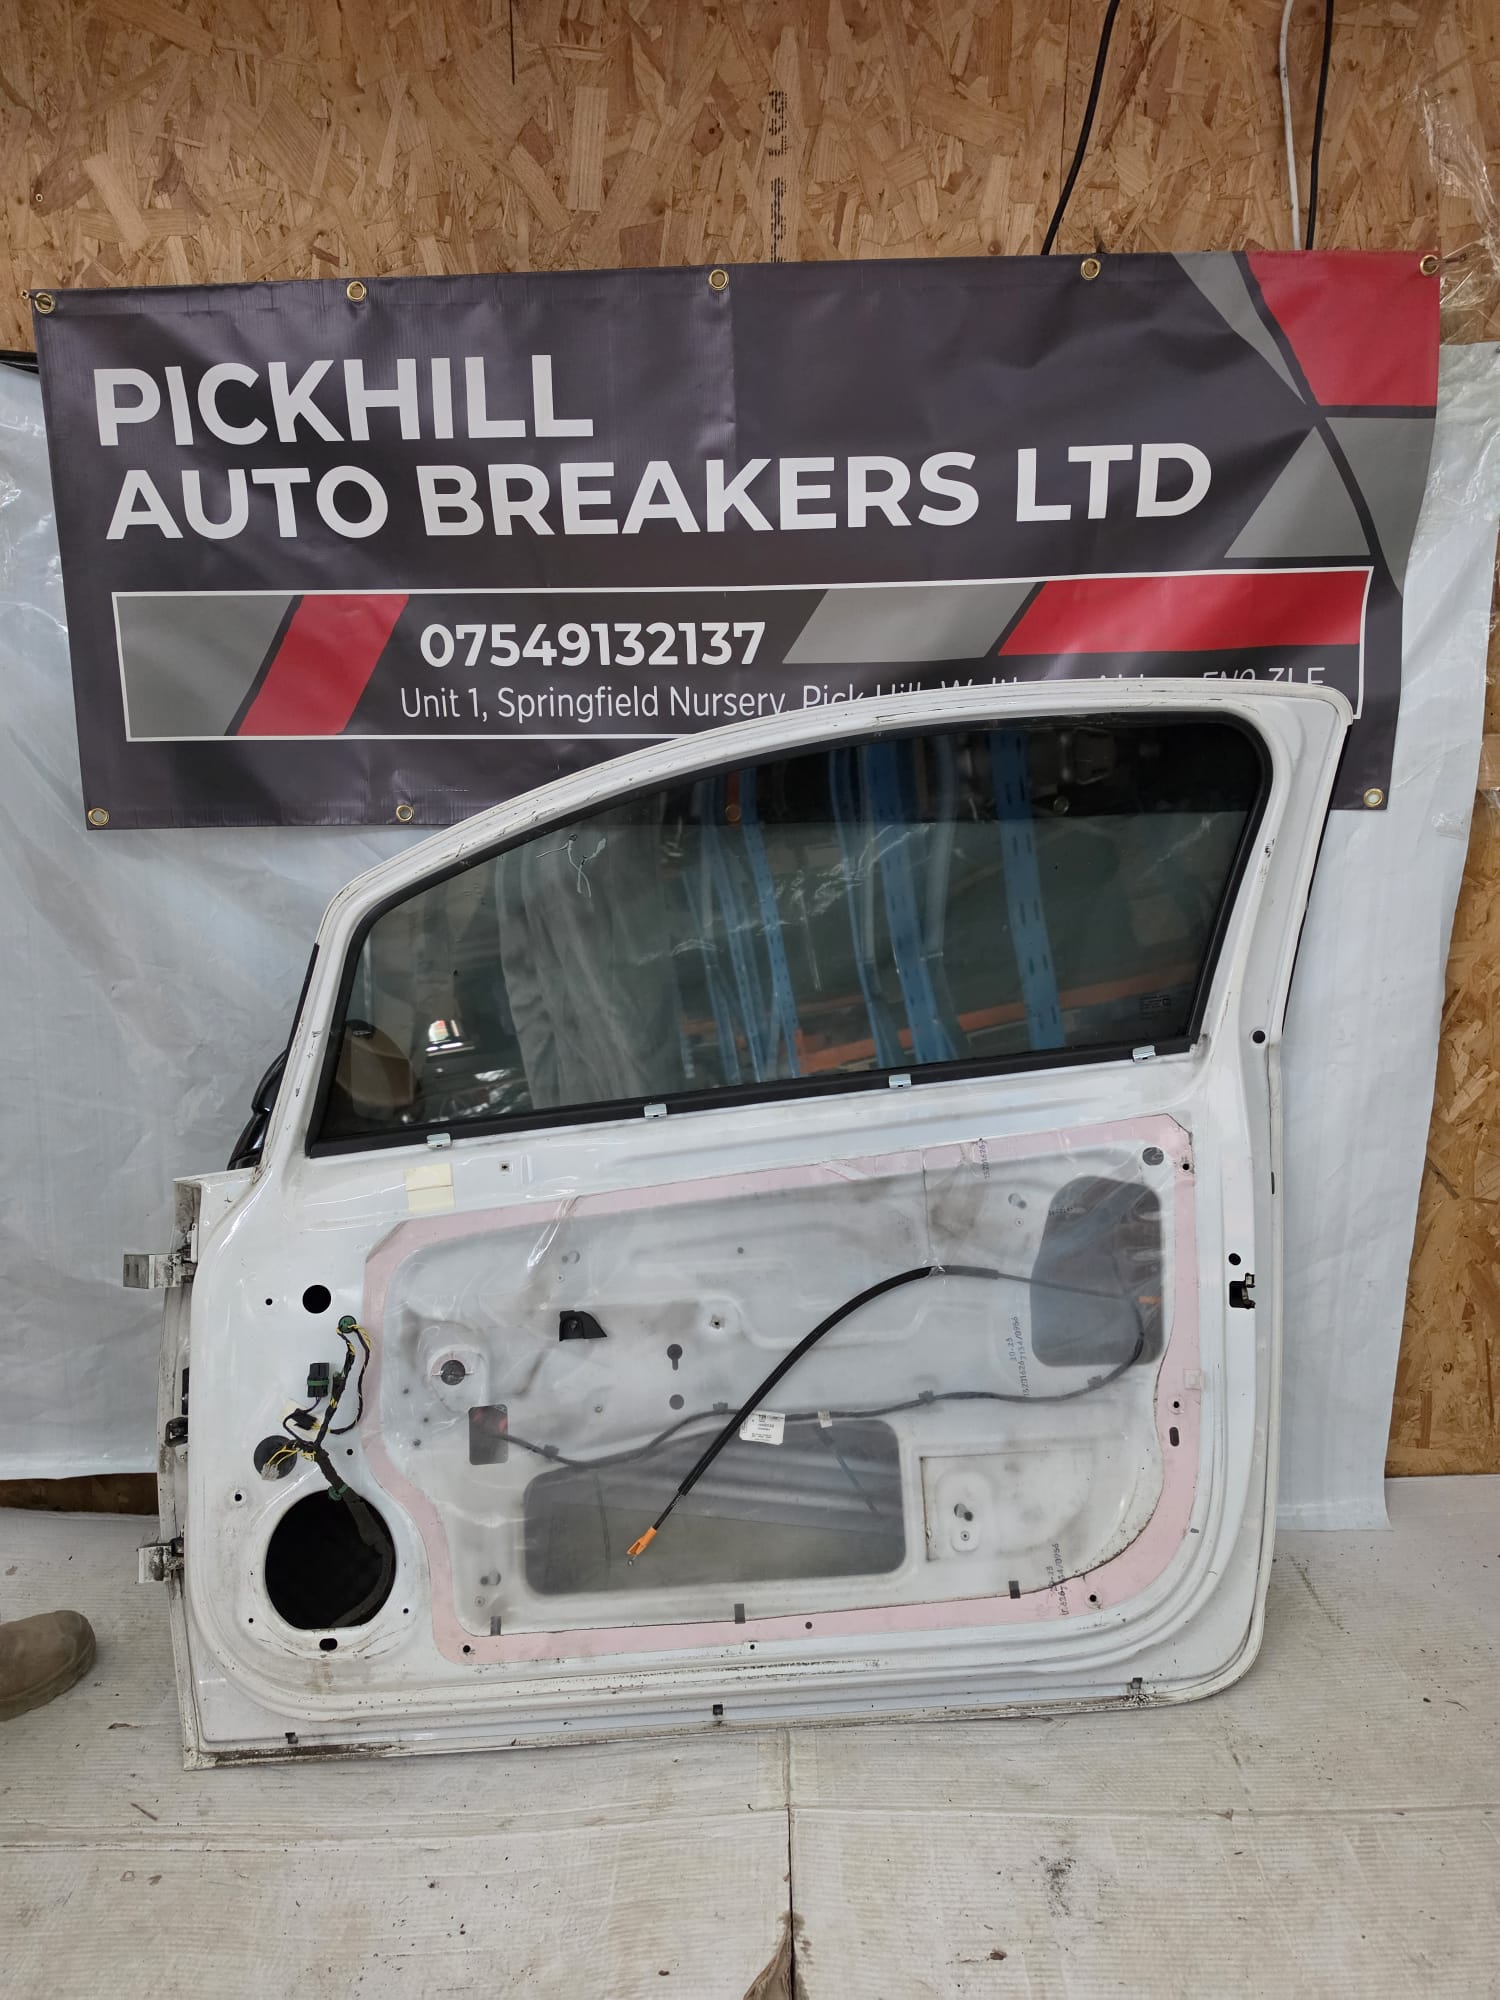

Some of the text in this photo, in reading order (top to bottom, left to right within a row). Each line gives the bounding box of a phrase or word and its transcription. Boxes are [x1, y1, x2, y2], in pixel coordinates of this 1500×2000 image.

[94, 355, 593, 446] PICKHILL
[106, 443, 1211, 539] AUTO BREAKERS LTD
[421, 622, 765, 667] 07549132137
[401, 687, 460, 717] Unit
[468, 687, 488, 722] 1,
[498, 686, 658, 723] Springfield
[670, 686, 790, 716] Nursery
